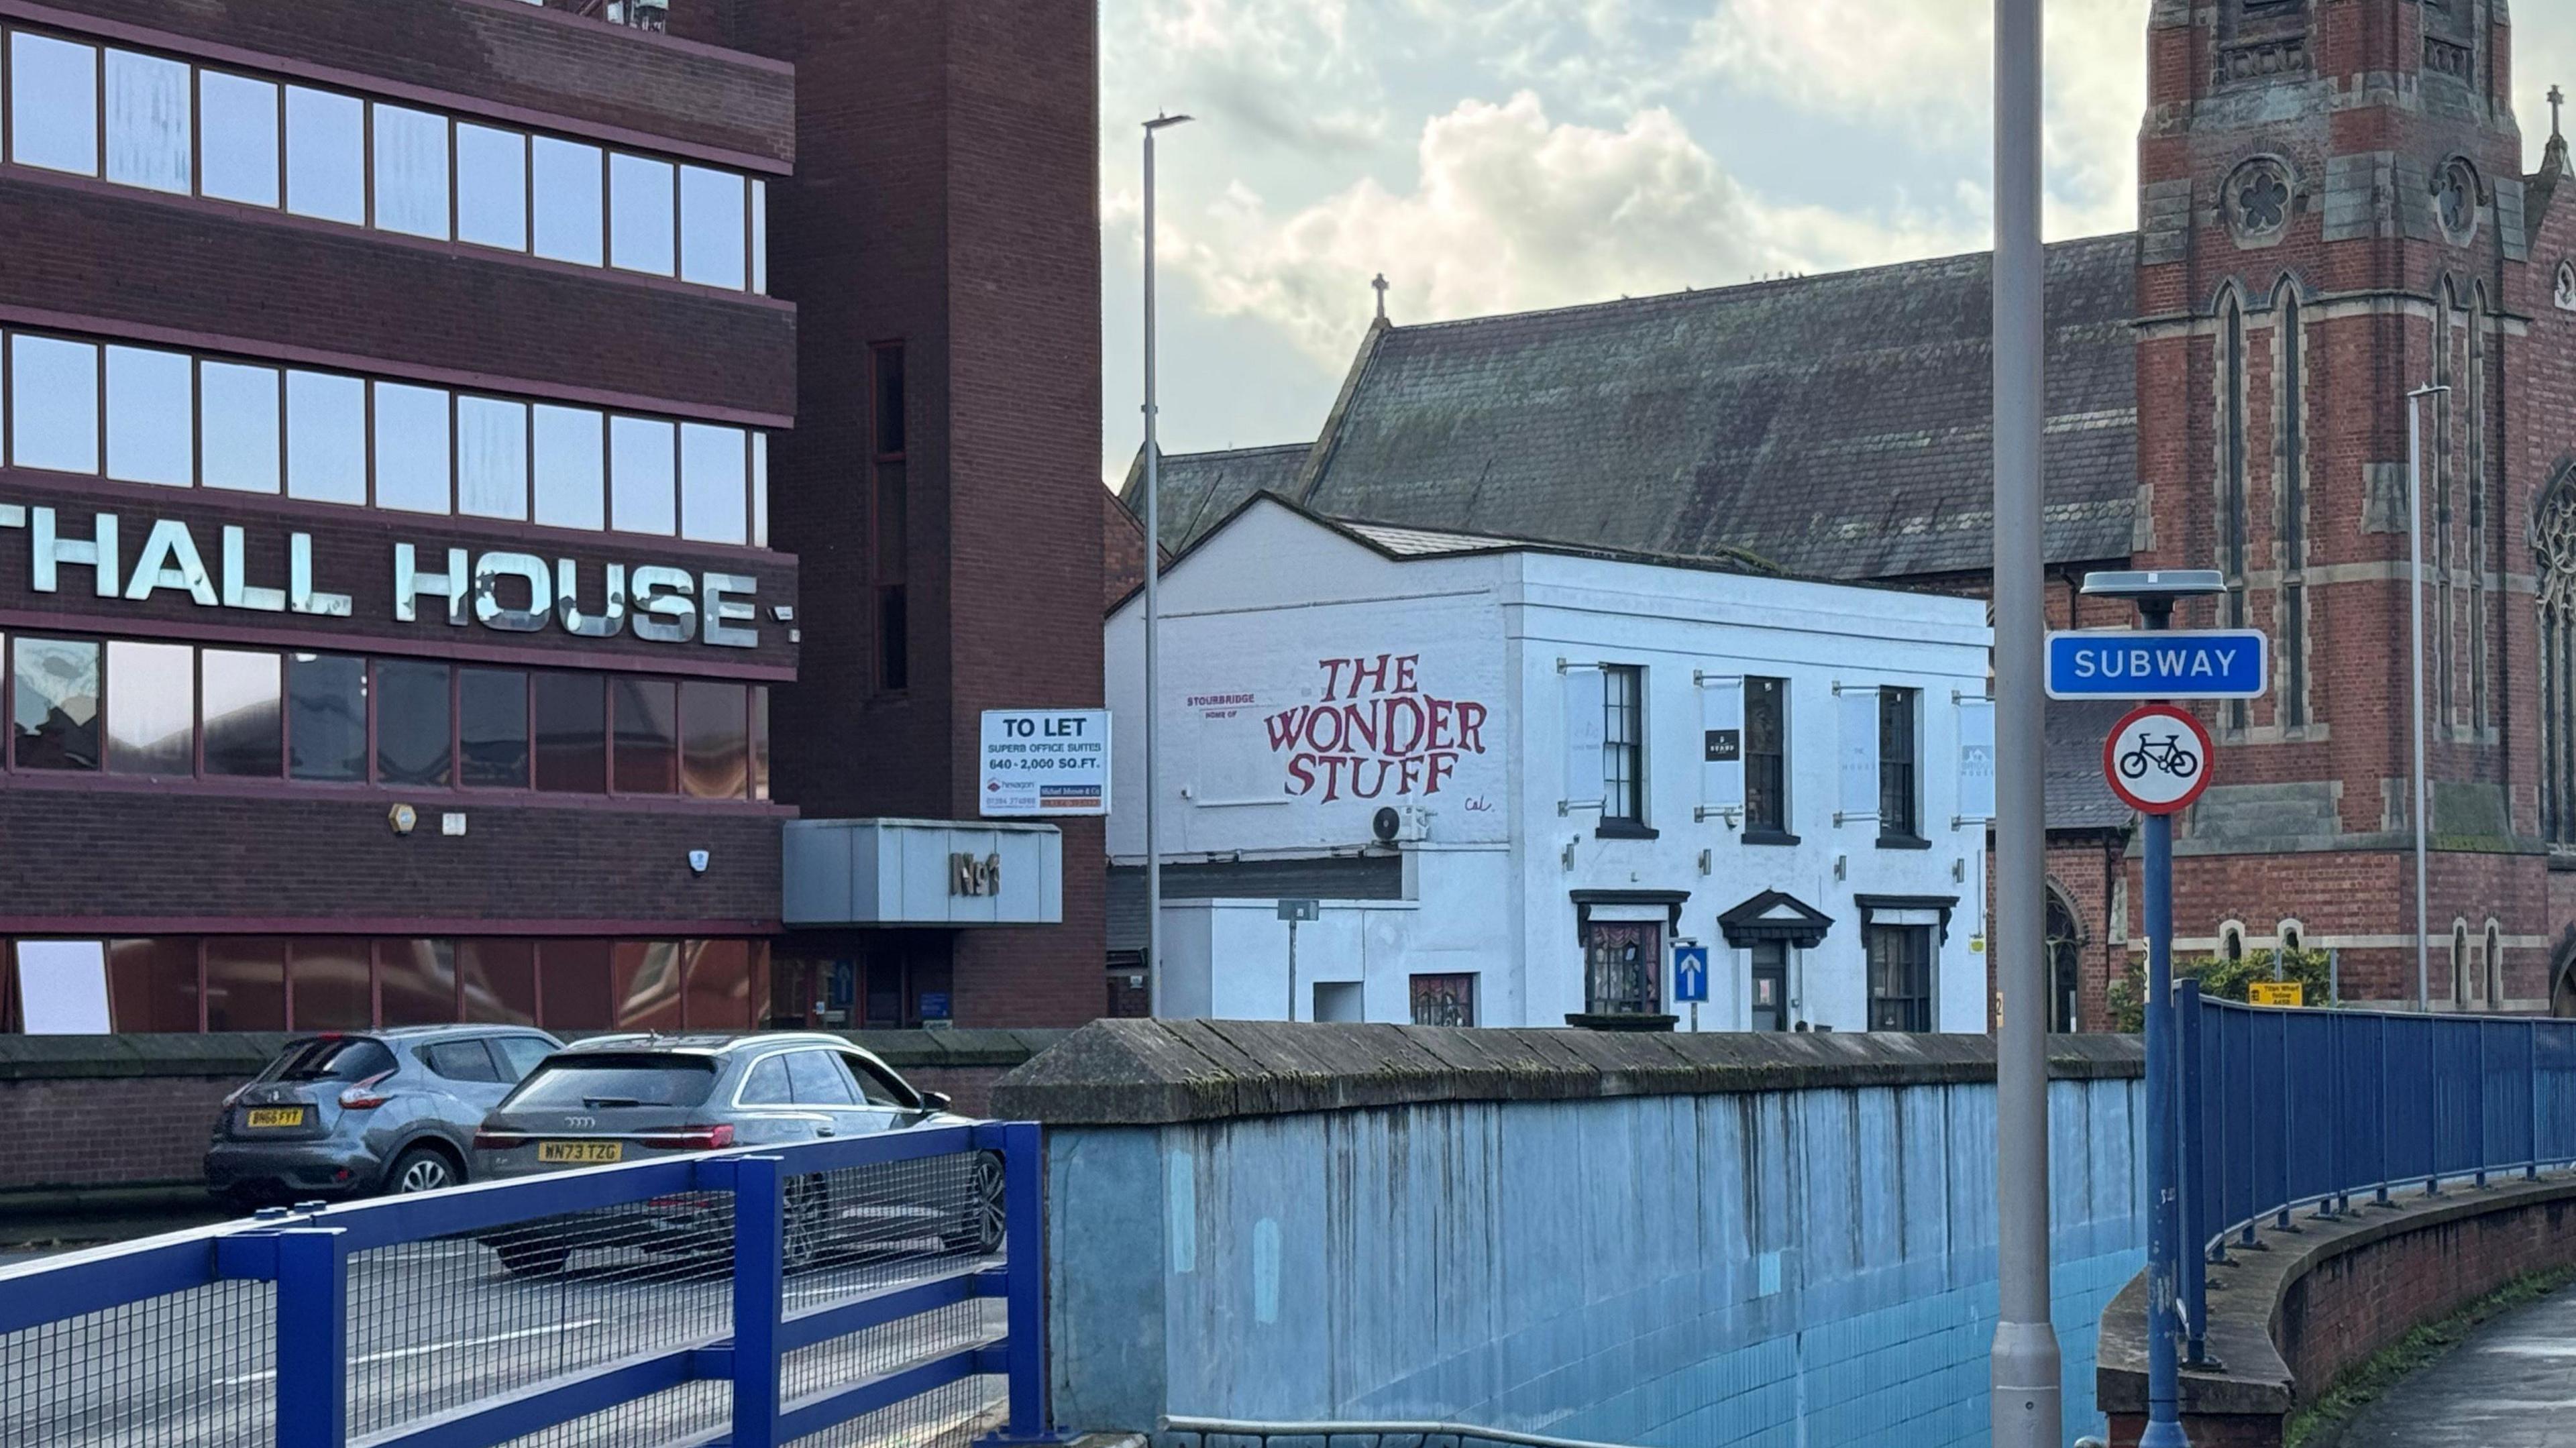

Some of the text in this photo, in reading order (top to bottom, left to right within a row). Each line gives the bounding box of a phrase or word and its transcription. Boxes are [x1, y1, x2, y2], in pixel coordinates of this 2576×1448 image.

[394, 543, 759, 648] HOUSE
[2074, 649, 2237, 678] SUBWAY
[1319, 654, 1419, 702] THE
[1187, 693, 1255, 706] STOURBRIDGE
[1205, 711, 1225, 719] HOME
[1264, 694, 1487, 757] WONDER
[1003, 718, 1087, 737] TO LET
[988, 743, 1102, 753] SUPERB OFFICE SUITES
[1284, 752, 1459, 805] STUFF
[588, 1144, 616, 1160] TZG
